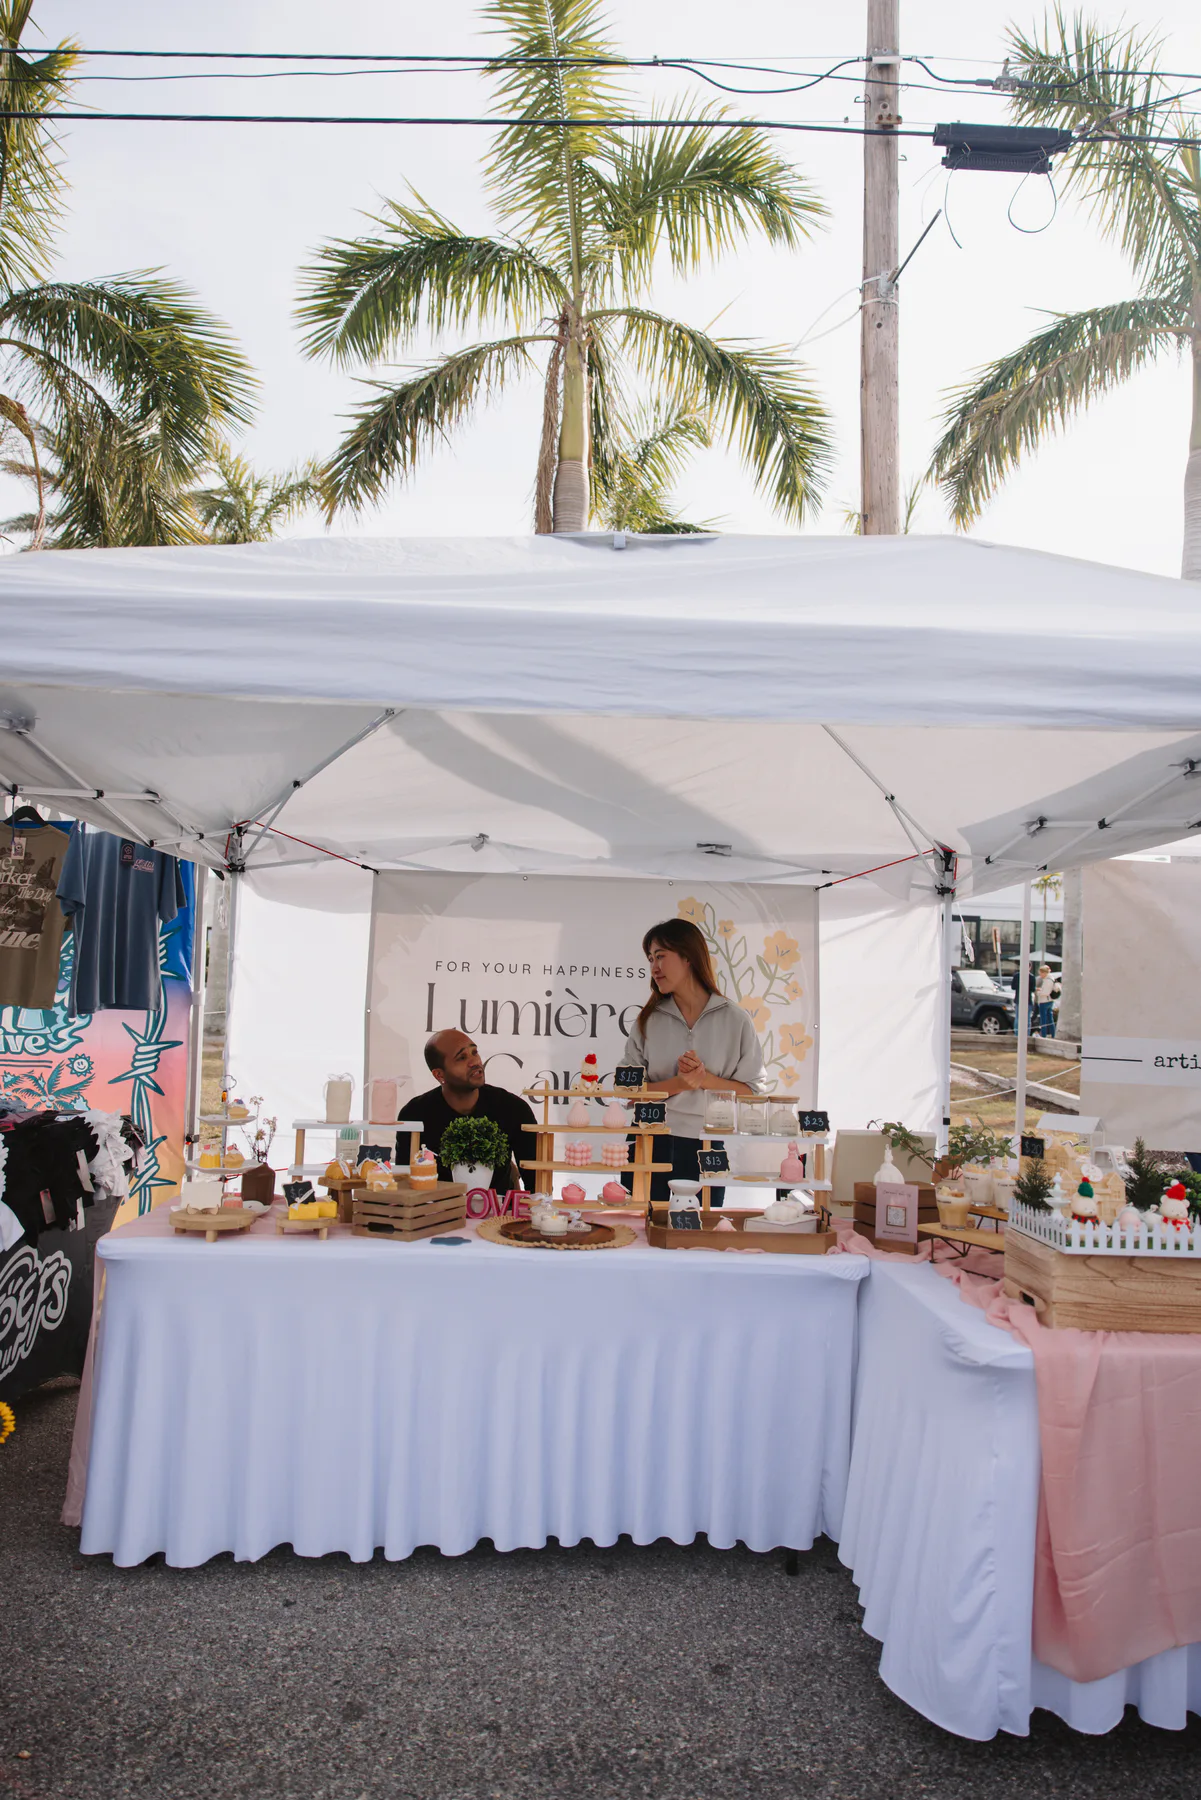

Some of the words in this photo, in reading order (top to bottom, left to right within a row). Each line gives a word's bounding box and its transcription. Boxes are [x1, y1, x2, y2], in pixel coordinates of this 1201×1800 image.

[0, 865, 36, 886] rker
[435, 960, 471, 973] FOR
[482, 962, 532, 975] YOUR
[543, 964, 646, 979] HAPPINESS
[1153, 1053, 1201, 1070] arti
[618, 1070, 638, 1083] $15
[639, 1107, 660, 1119] $10
[705, 1155, 722, 1166] $13
[676, 1214, 693, 1230] $5
